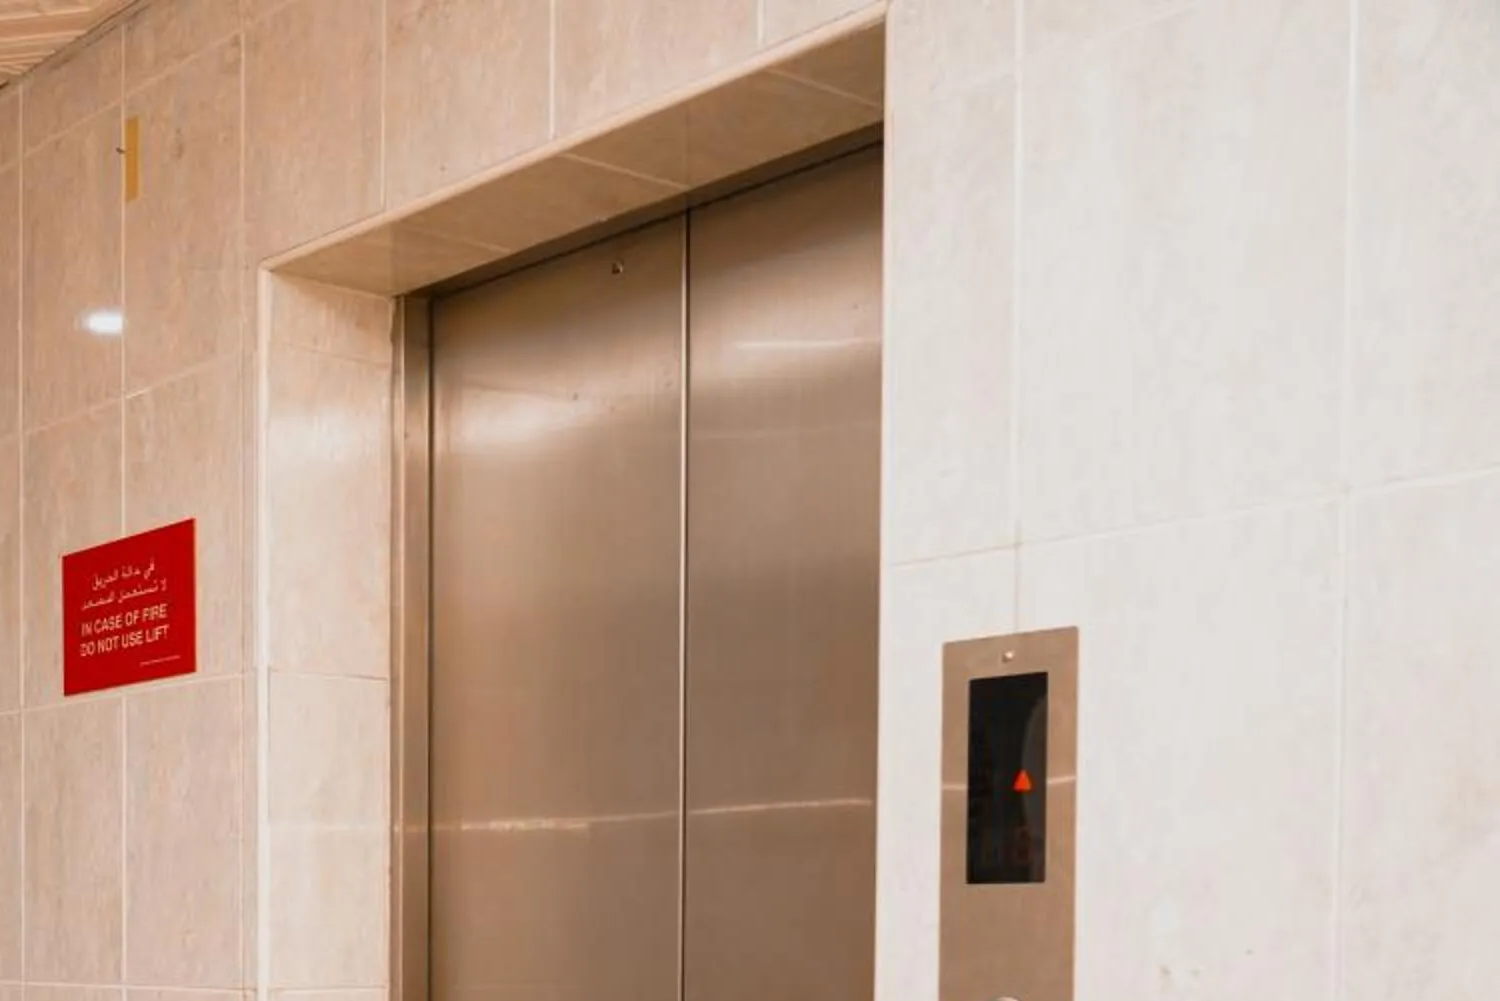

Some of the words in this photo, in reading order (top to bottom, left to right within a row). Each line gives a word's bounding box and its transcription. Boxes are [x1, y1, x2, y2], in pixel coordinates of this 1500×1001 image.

[81, 622, 93, 637] IN
[94, 612, 123, 634] CASE
[125, 609, 140, 627] OF
[142, 603, 168, 622] FIRE
[80, 641, 96, 657] DO
[97, 635, 120, 654] NOT
[121, 630, 144, 649] USE
[145, 624, 170, 643] LIFT
